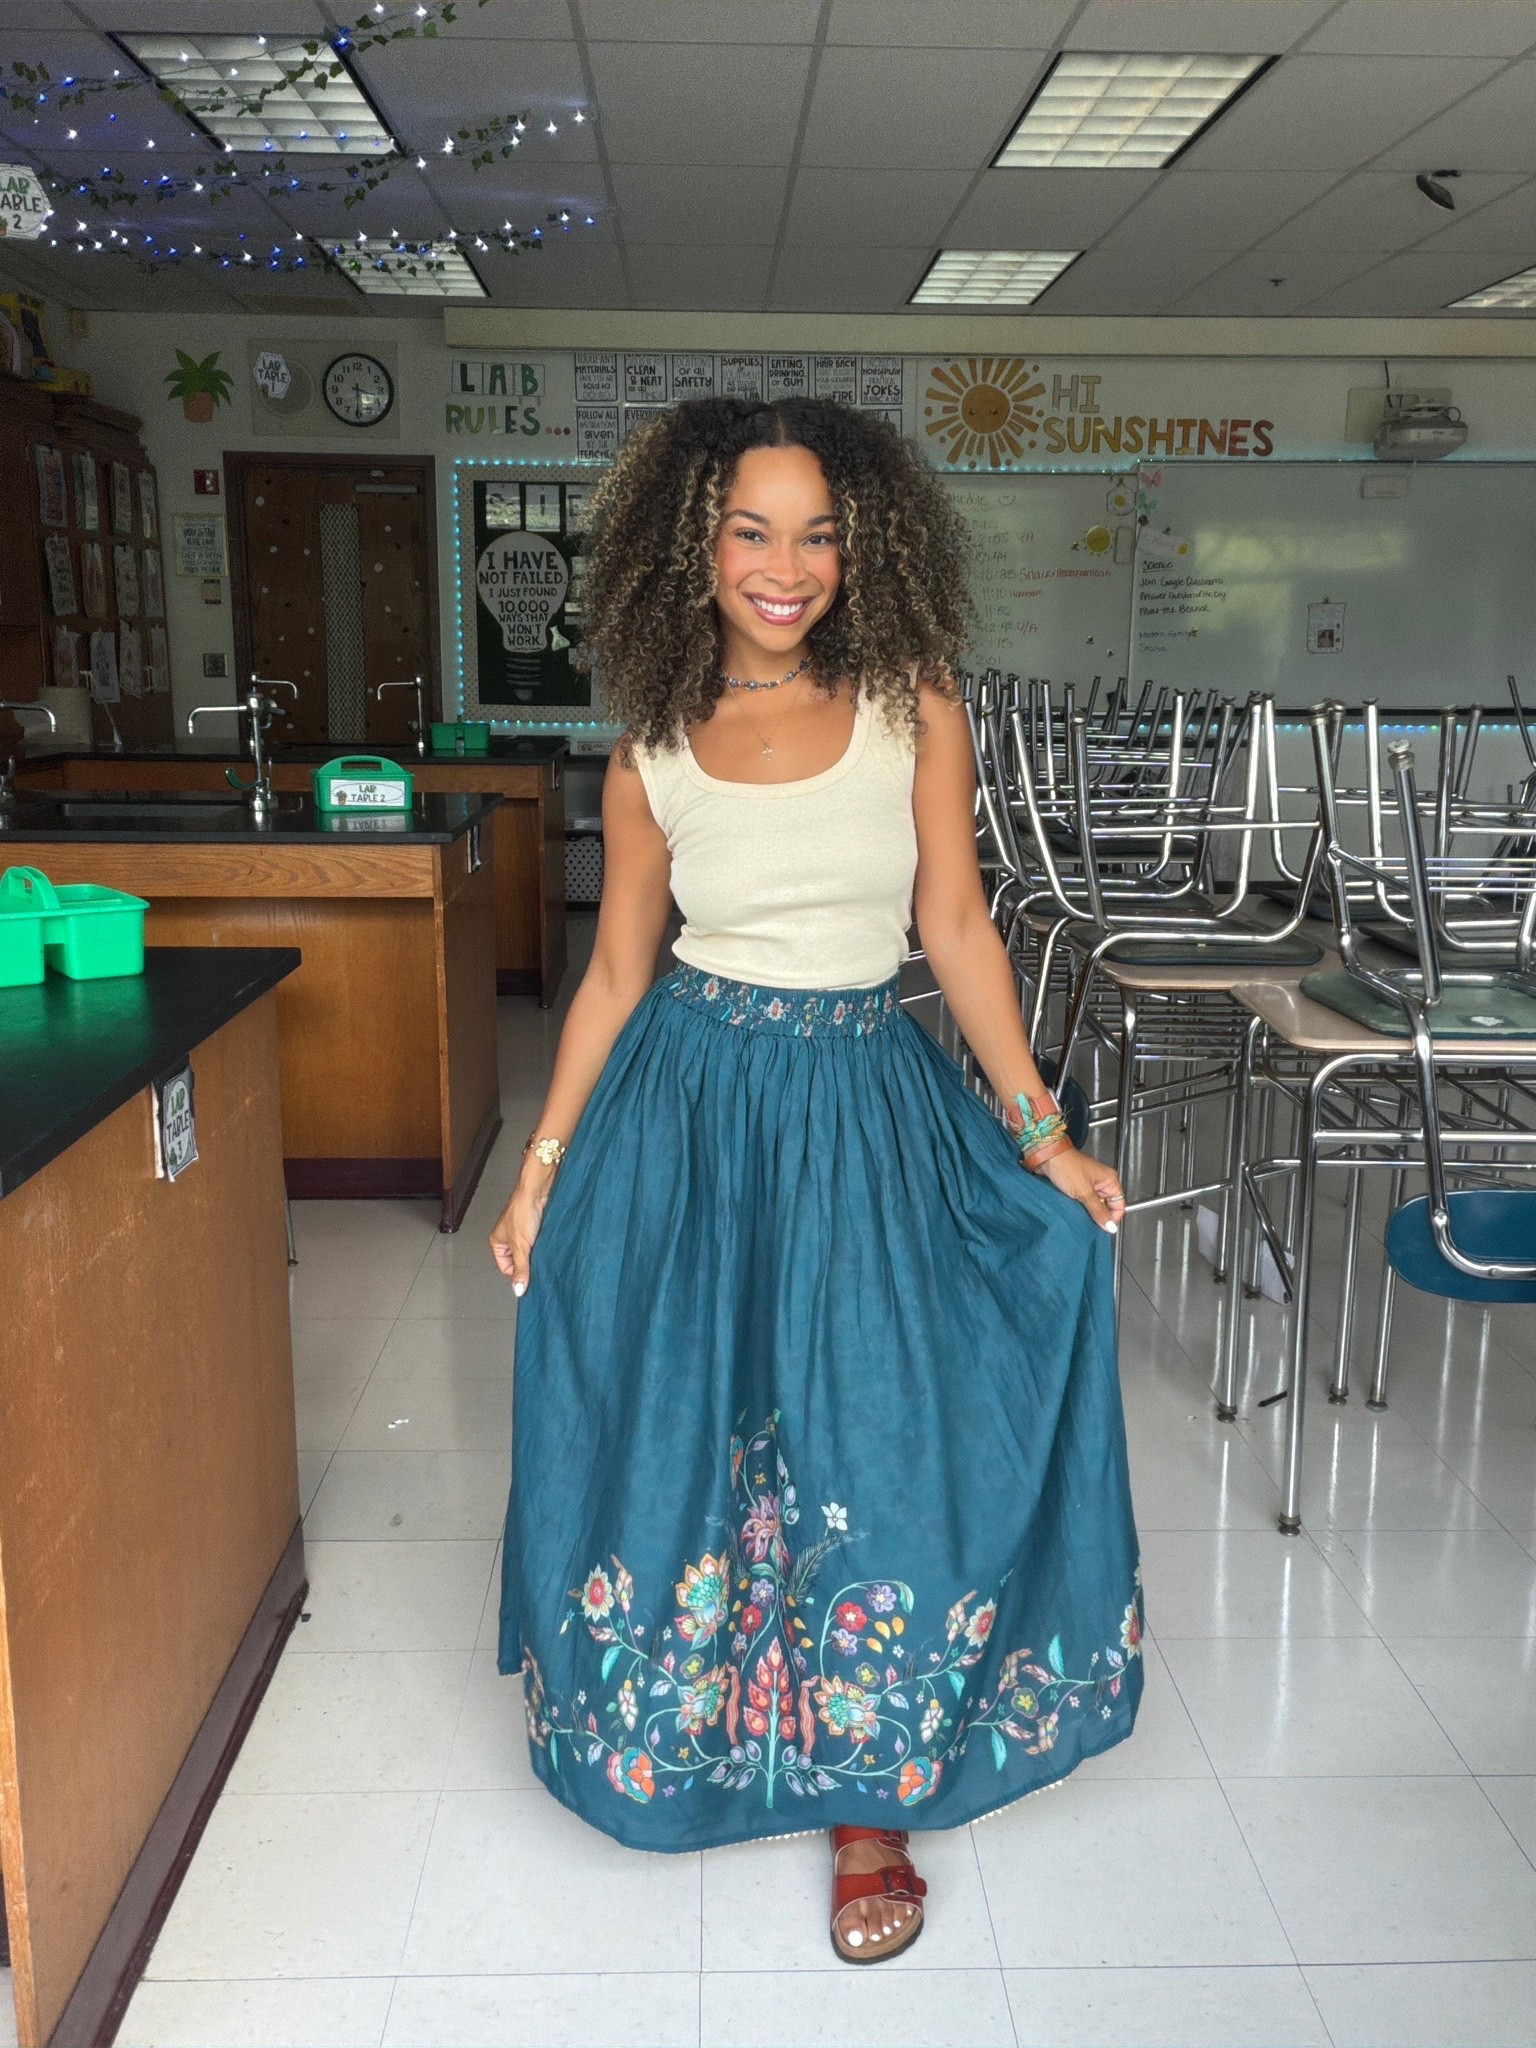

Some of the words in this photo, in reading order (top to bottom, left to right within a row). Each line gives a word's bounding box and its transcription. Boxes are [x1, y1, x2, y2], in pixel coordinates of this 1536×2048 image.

[0, 193, 42, 213] ABLE
[13, 213, 22, 229] 2
[262, 358, 281, 372] LAB
[342, 365, 350, 374] 11
[353, 361, 362, 372] 12
[575, 365, 617, 374] MATERIALS
[626, 364, 656, 375] CLEAN
[771, 359, 805, 369] EATING,
[816, 360, 834, 368] HAIR
[836, 360, 857, 368] BACK
[257, 368, 288, 384] TABLE
[333, 374, 343, 384] 10
[459, 363, 539, 396] LAB
[640, 375, 663, 386] NEAT
[674, 376, 713, 388] SAFETY
[783, 378, 804, 387] GUM
[863, 384, 901, 396] JOKES
[1052, 373, 1102, 414] HI
[832, 390, 855, 402] FIRE
[578, 410, 604, 420] FOLLOW
[585, 430, 614, 440] given
[1043, 415, 1275, 458] SUNSHINES
[486, 551, 495, 570] I
[503, 551, 559, 570] HAVE
[1142, 560, 1174, 571] Science
[478, 571, 508, 585] NOT
[512, 571, 567, 585] FAILED.
[1139, 577, 1157, 588] Join
[1160, 576, 1185, 590] Google
[488, 588, 494, 598] I
[497, 588, 521, 598] JUST
[523, 587, 558, 598] FOUND
[1139, 591, 1166, 601] Answer
[498, 613, 523, 623] WAYS
[525, 612, 549, 623] THAT
[506, 624, 542, 635] WON'T
[507, 635, 544, 647] WORK.
[359, 785, 376, 793] LAB
[352, 794, 377, 802] TABLE
[380, 794, 386, 802] 2
[166, 1108, 189, 1145] TABLE
